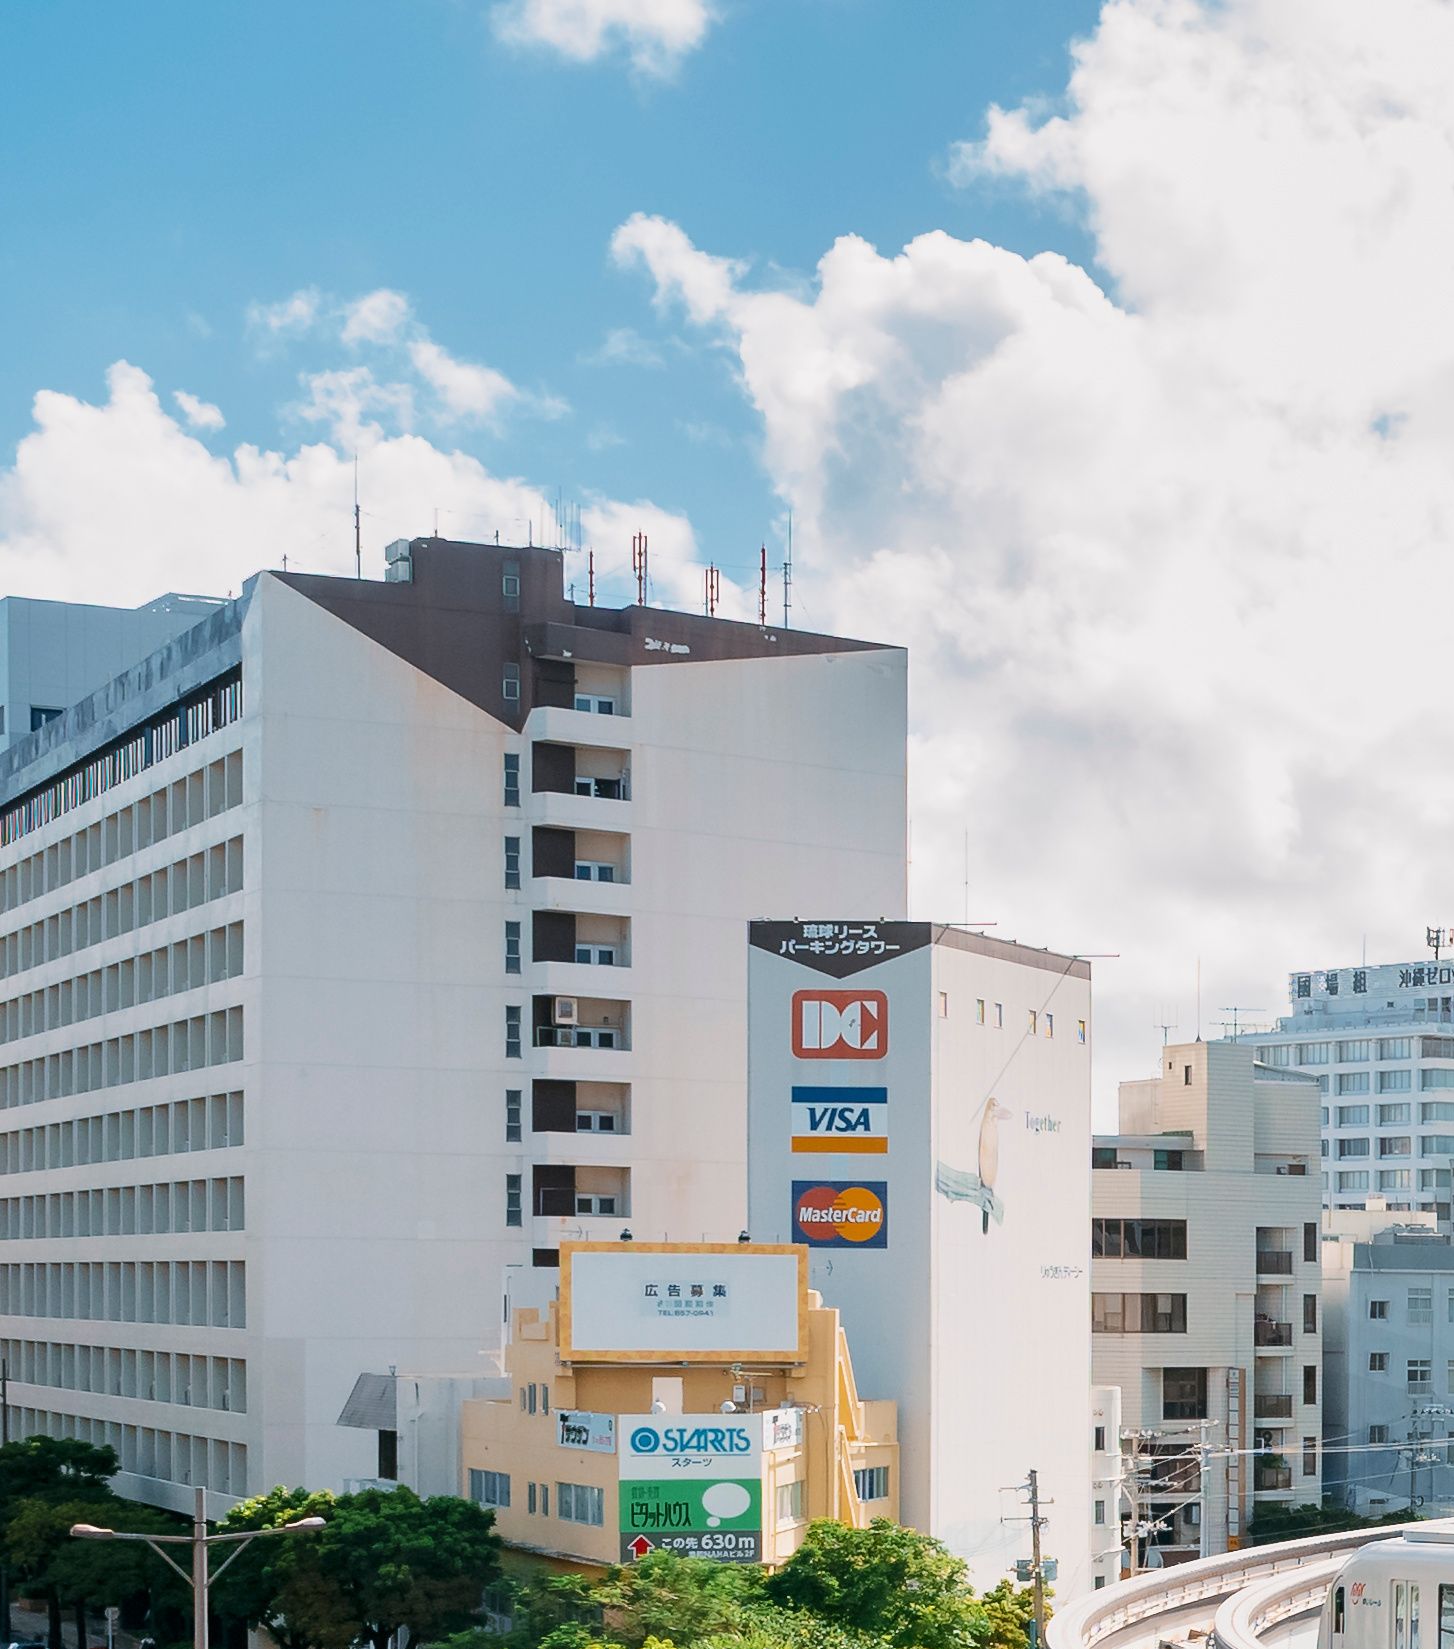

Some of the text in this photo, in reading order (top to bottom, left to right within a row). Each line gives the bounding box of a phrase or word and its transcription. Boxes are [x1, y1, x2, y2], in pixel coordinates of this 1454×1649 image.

[802, 924, 878, 939] 琉球リース
[779, 939, 900, 955] パーキングタワー
[801, 1000, 878, 1050] DC
[806, 1106, 871, 1132] VISA
[1024, 1110, 1062, 1134] Together
[798, 1206, 882, 1224] MasterCard
[671, 1457, 713, 1468] スターツ
[630, 1501, 692, 1528] ピタットハウス
